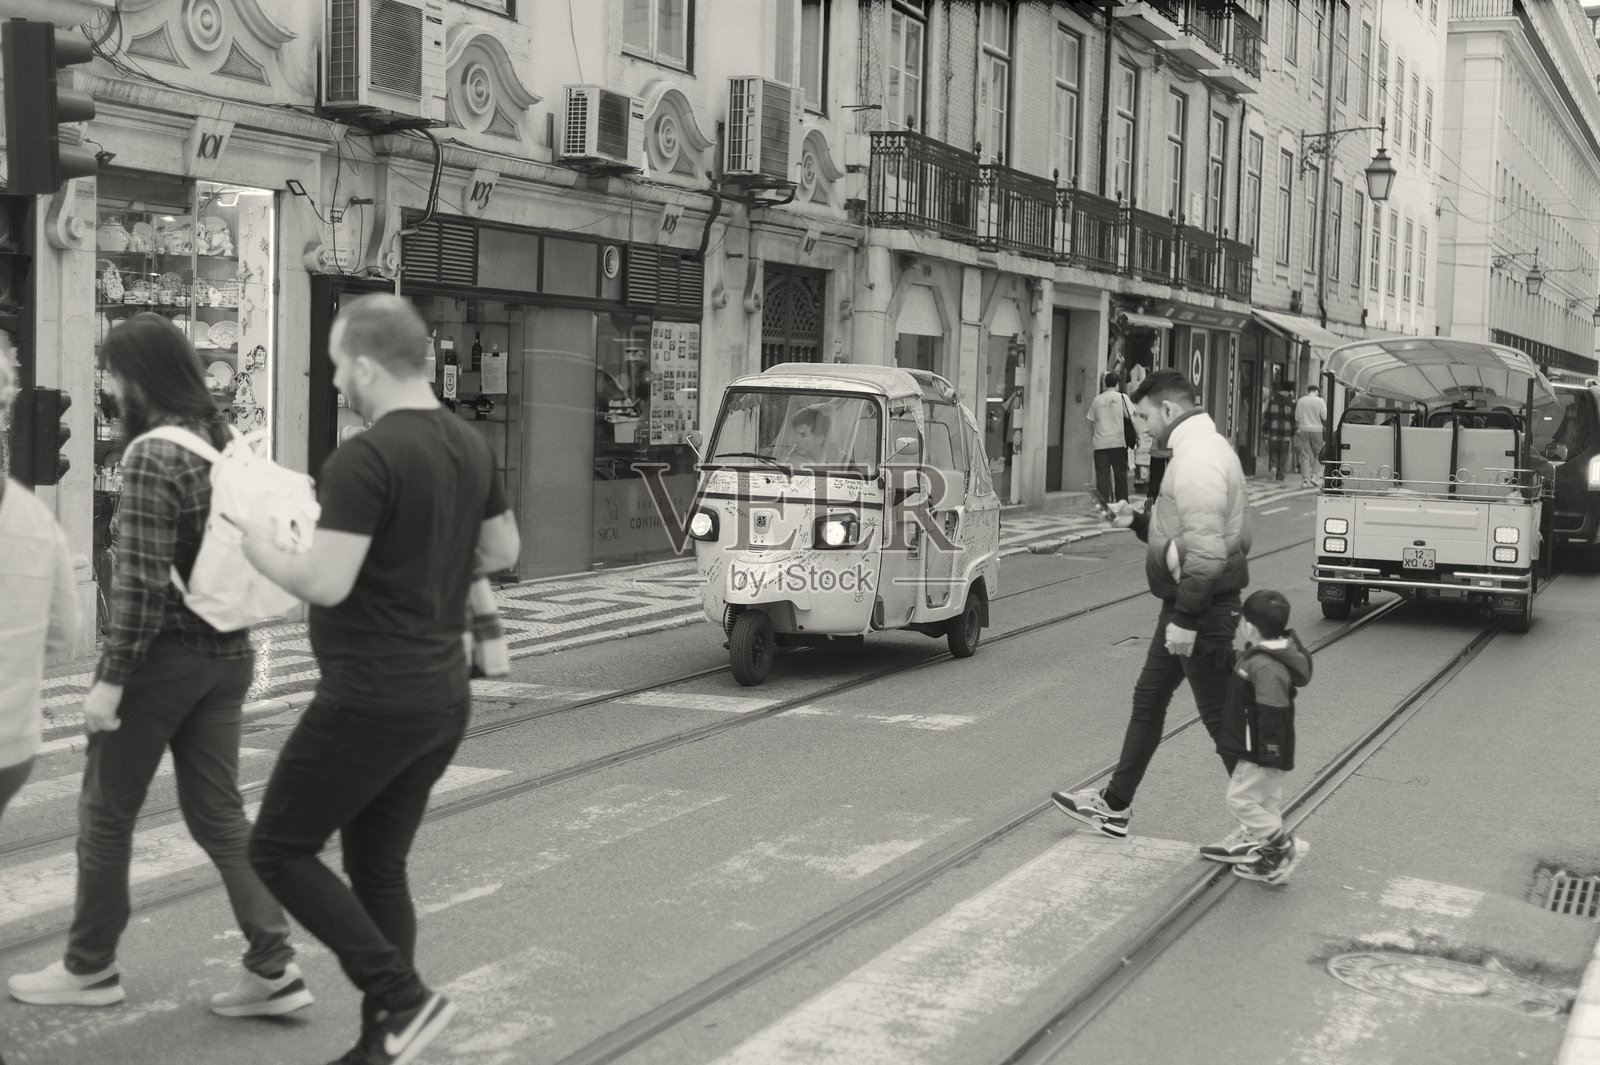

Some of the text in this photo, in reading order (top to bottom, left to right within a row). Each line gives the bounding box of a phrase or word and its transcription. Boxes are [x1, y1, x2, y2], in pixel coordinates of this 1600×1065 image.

[196, 133, 224, 160] 101
[470, 181, 493, 210] 103
[661, 213, 680, 235] 105
[1415, 550, 1424, 559] 12
